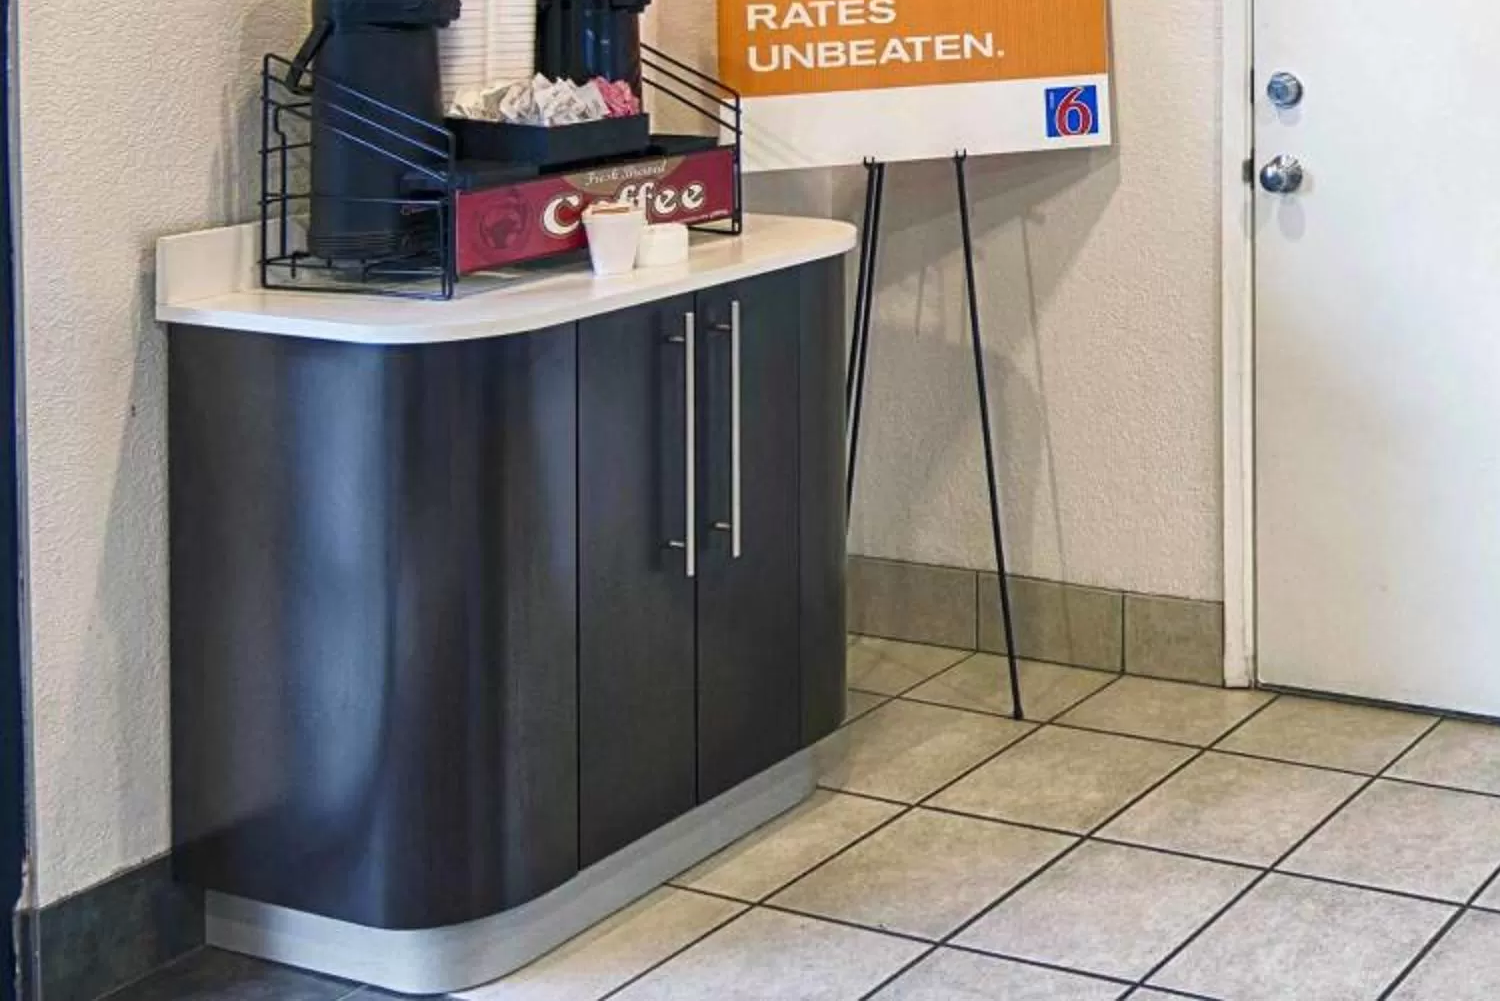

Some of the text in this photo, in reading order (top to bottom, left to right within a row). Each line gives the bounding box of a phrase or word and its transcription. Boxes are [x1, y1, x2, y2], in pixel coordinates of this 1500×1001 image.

[748, 32, 1005, 72] UNBEATEN.
[1055, 86, 1093, 137] 6
[544, 182, 705, 236] Cffee
